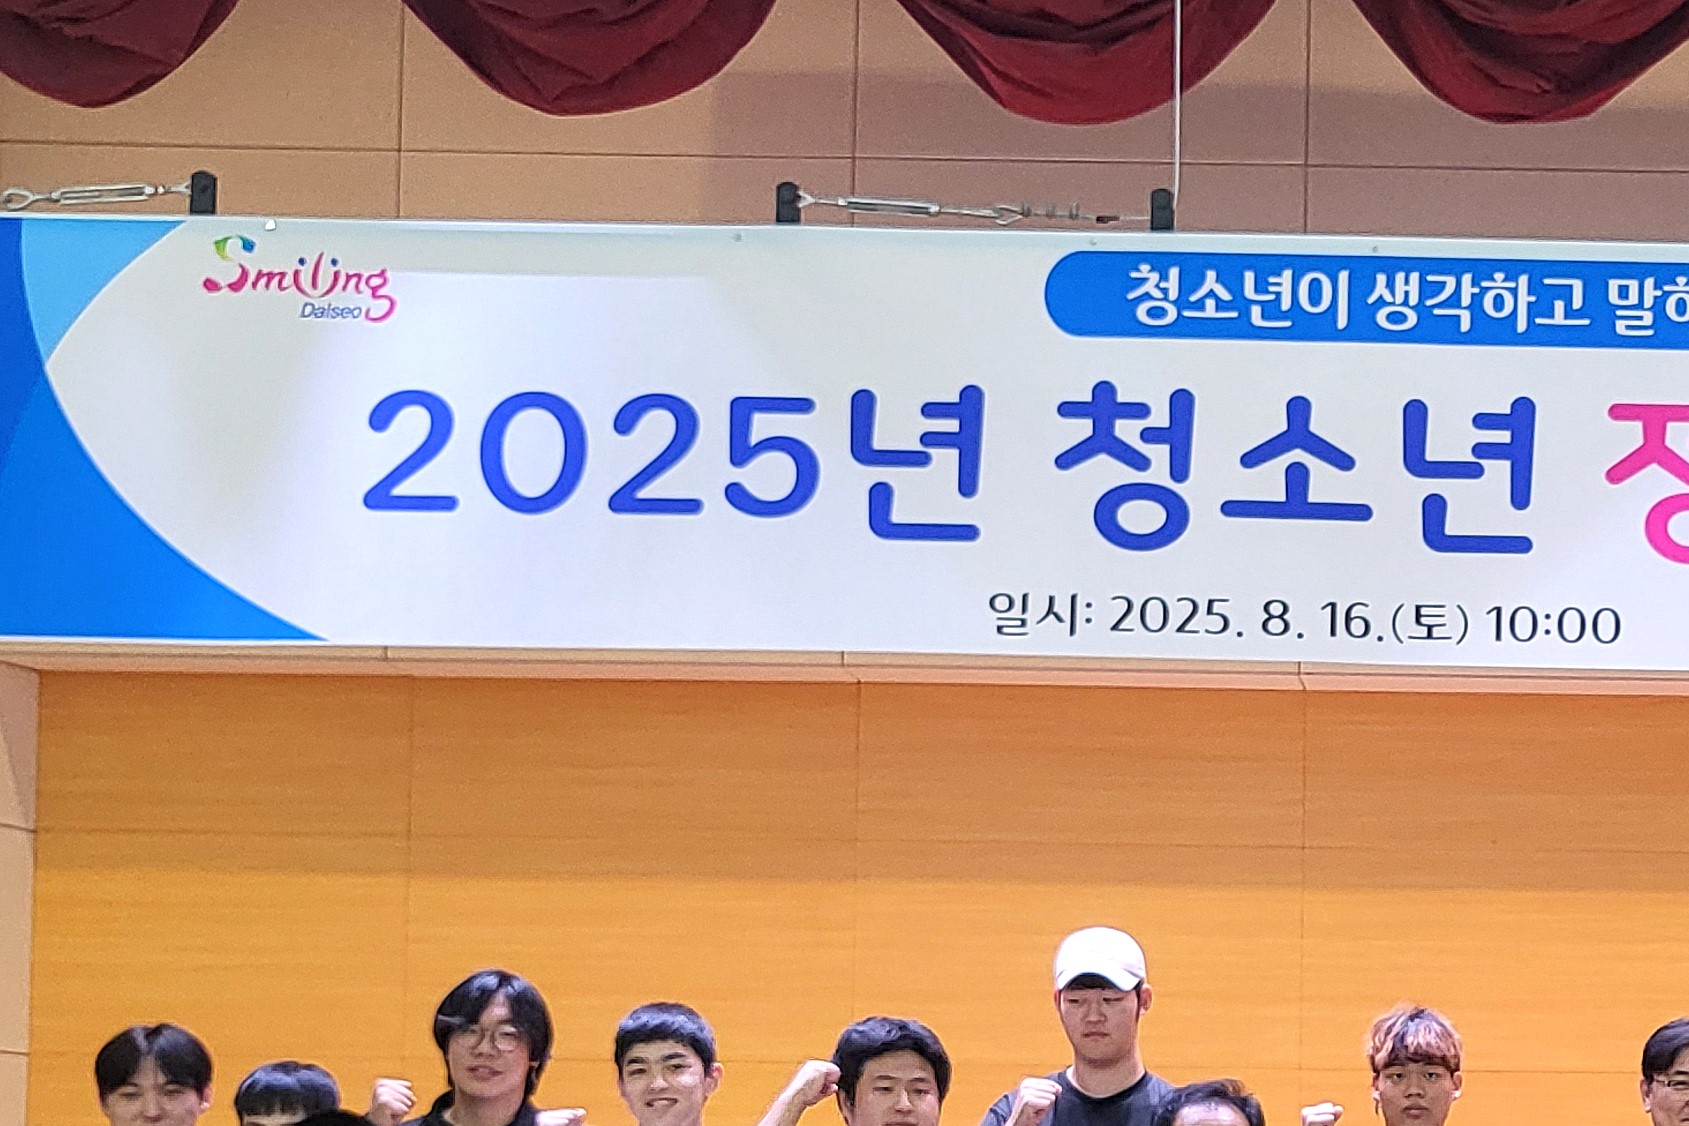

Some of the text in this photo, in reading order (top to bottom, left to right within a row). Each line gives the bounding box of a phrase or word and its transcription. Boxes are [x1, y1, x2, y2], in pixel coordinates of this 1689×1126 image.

[203, 234, 397, 323] Smiling
[300, 302, 362, 320] Dalseo
[1126, 263, 1351, 331] 청소년이
[1367, 271, 1592, 334] 생각하고
[363, 384, 985, 542] 2025년
[1054, 380, 1536, 554] 청소년
[989, 592, 1621, 645] 일시: 2025. 8. 16.(토) 10:00
